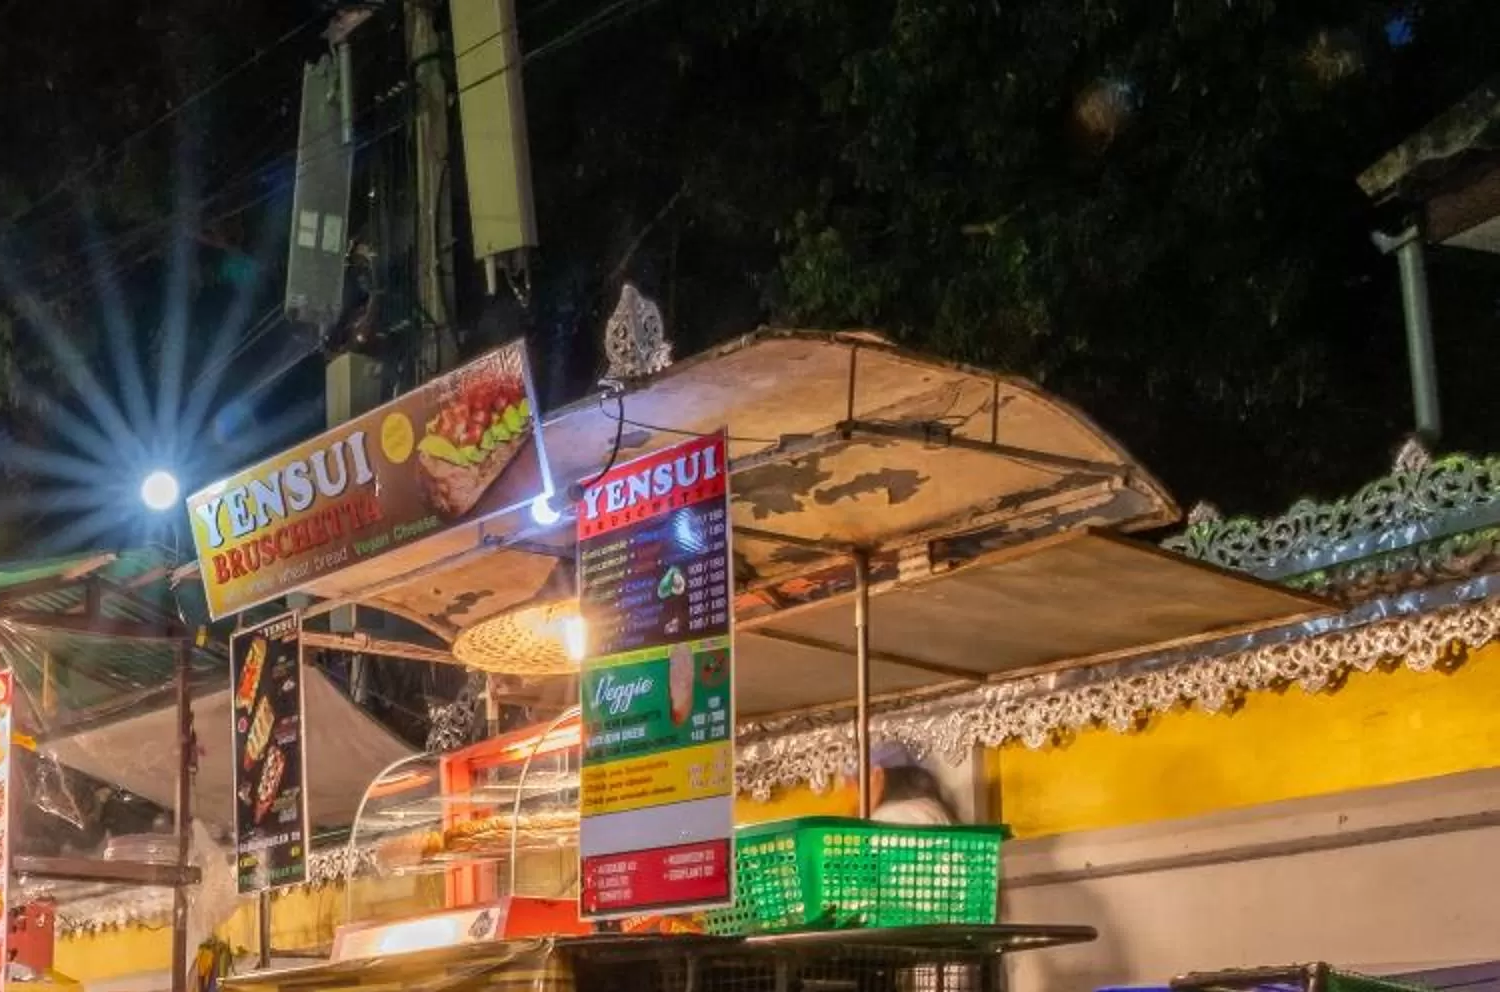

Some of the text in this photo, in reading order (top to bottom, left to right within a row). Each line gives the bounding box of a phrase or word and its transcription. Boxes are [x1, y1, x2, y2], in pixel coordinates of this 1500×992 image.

[195, 431, 373, 548] YENSUI
[583, 446, 717, 520] YENSUI
[211, 491, 383, 585] BRUSCHETTA
[589, 673, 654, 715] Veggie
